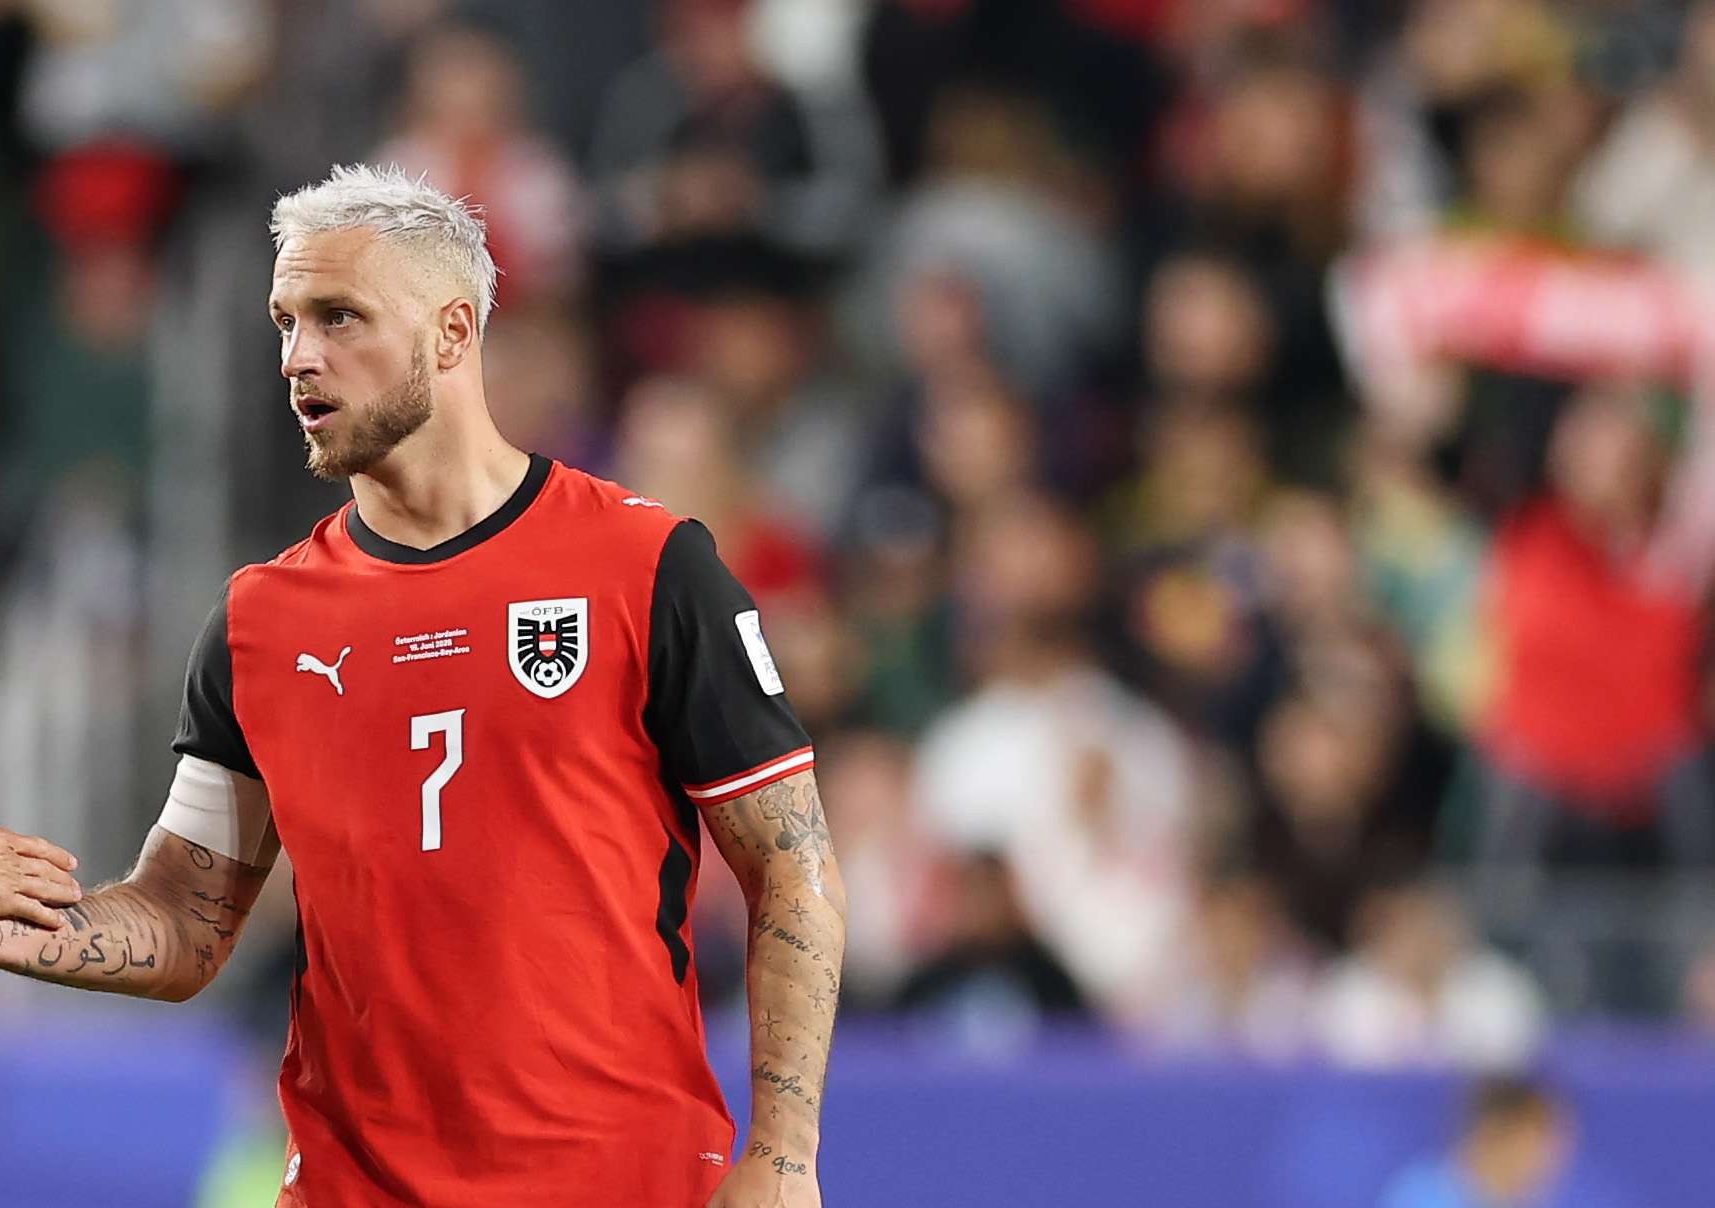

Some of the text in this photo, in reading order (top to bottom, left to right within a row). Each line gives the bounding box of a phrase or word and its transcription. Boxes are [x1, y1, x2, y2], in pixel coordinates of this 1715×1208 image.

[531, 606, 564, 616] ÖFB
[434, 629, 467, 640] Jordanien
[410, 708, 466, 852] 7
